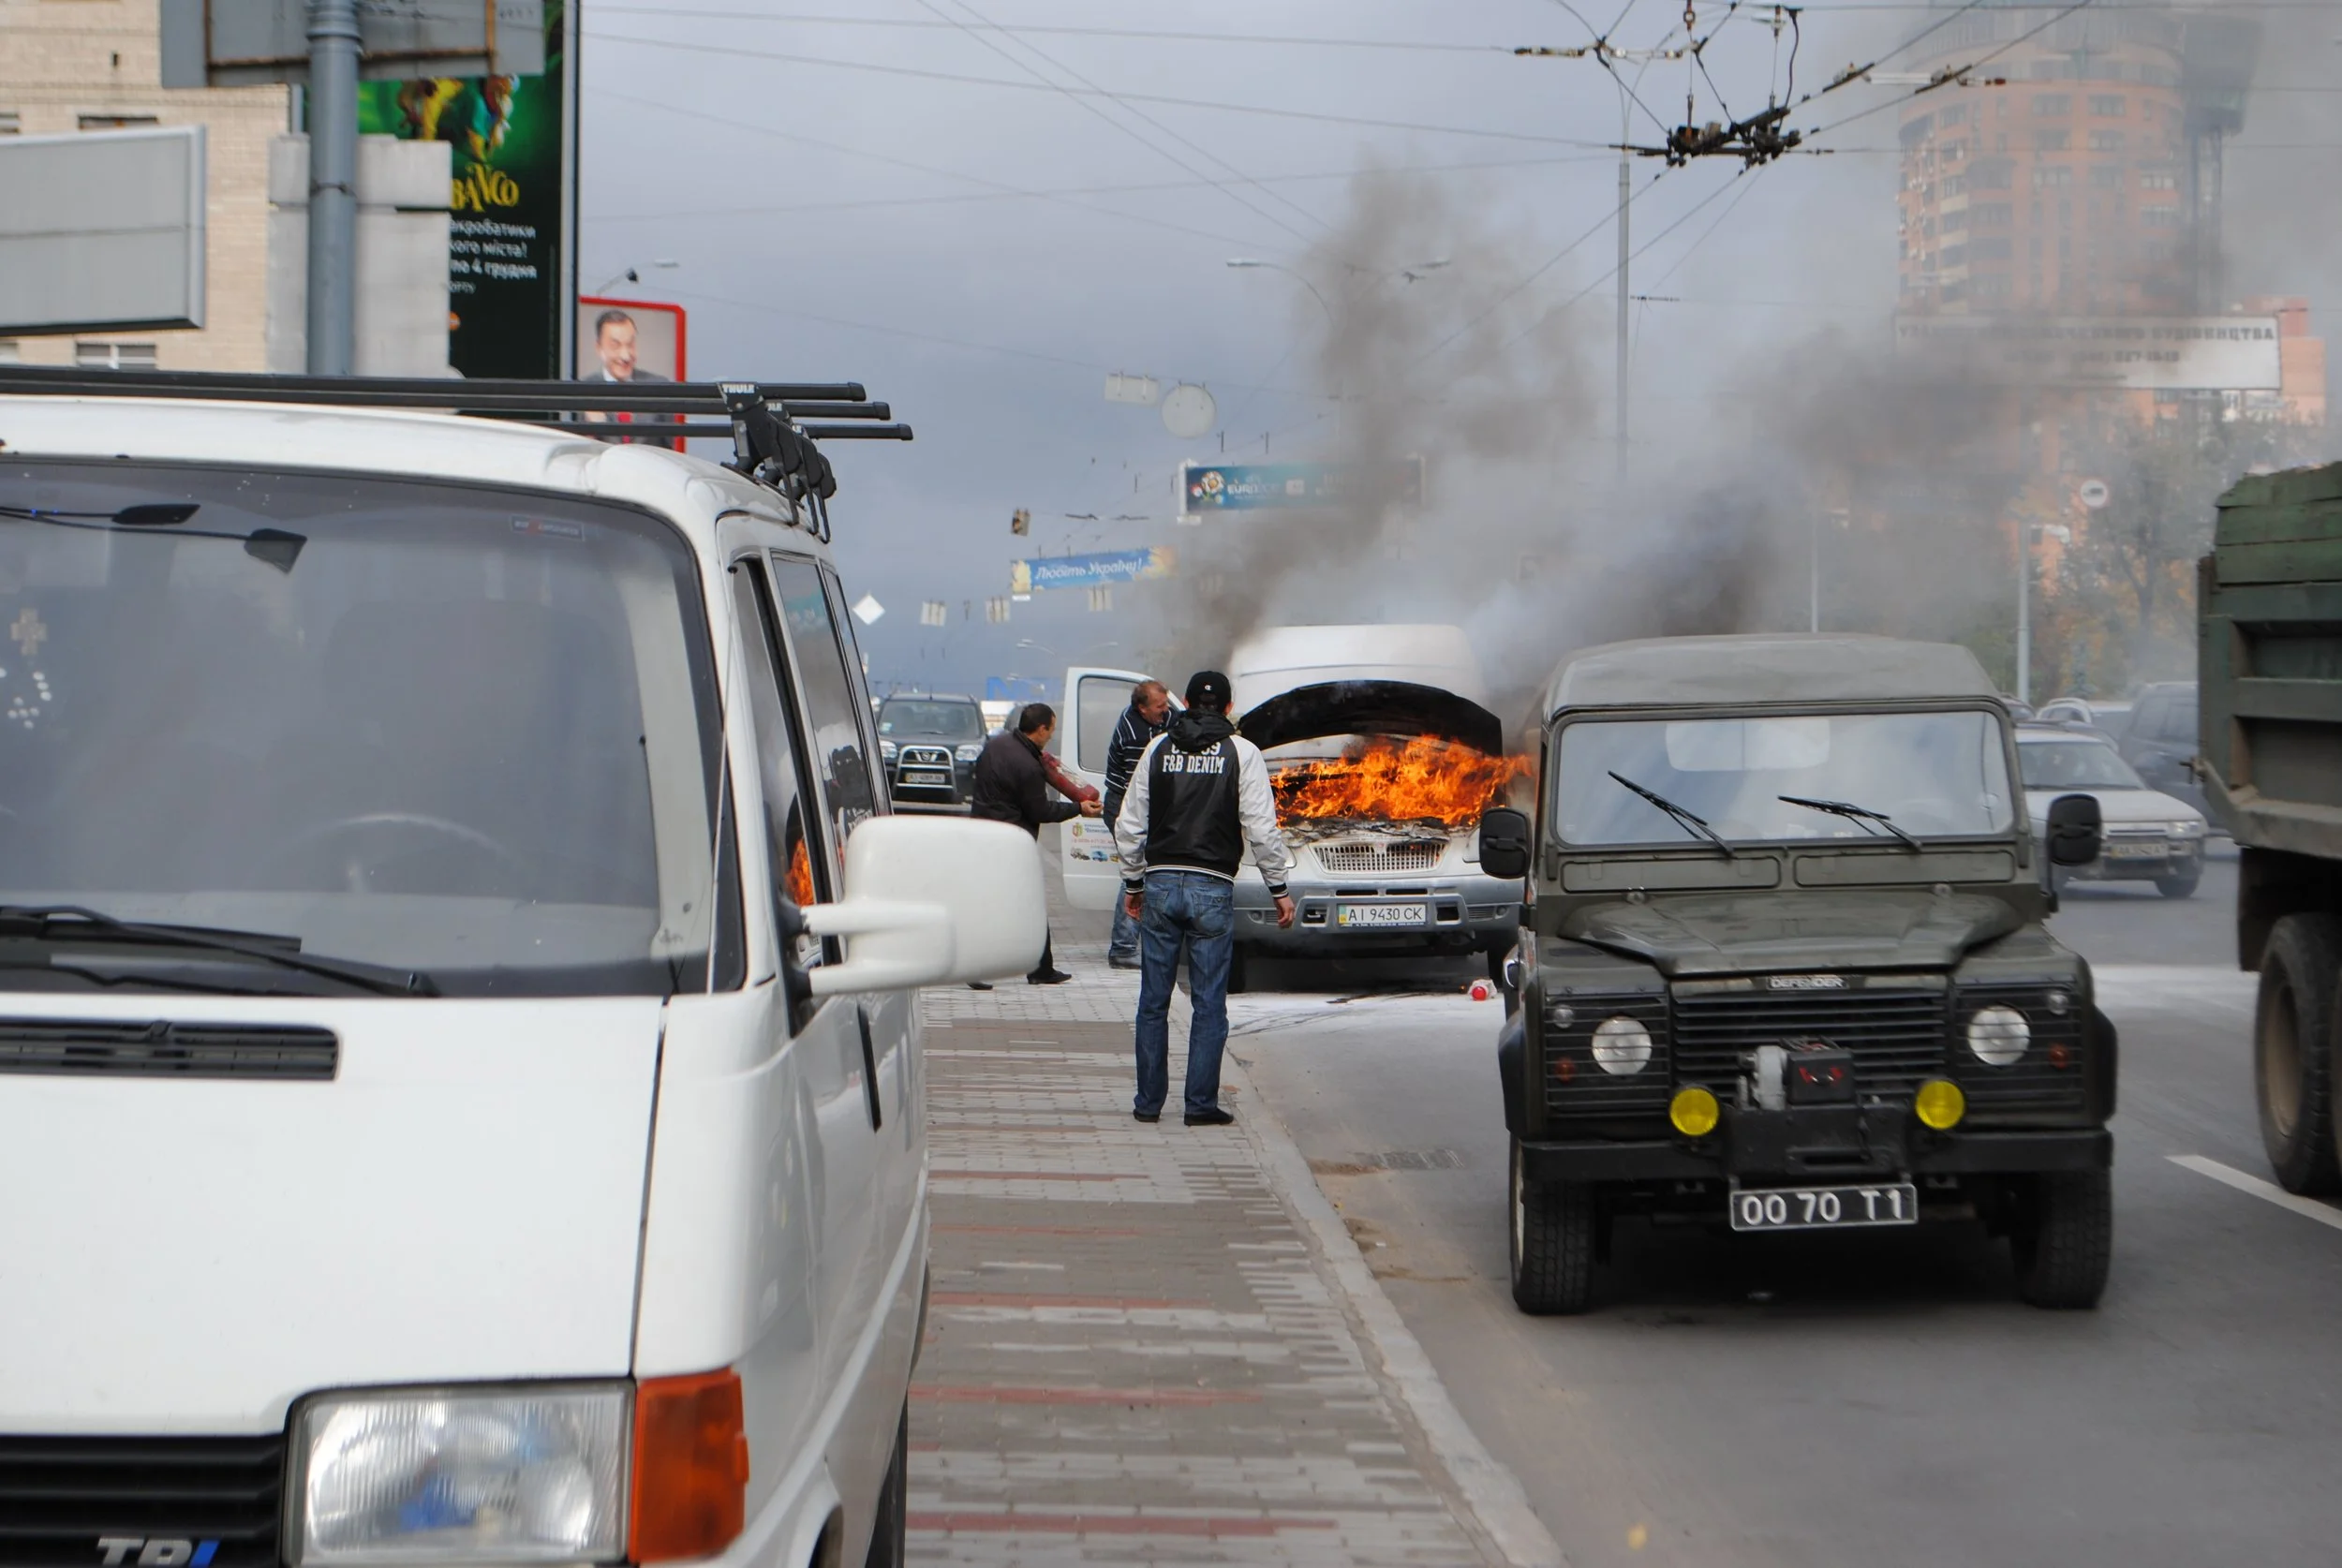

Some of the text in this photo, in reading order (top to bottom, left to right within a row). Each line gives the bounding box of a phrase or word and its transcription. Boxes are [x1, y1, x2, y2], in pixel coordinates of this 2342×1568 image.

[484, 261, 538, 279] грудня
[1088, 557, 1143, 577] Україну!
[1162, 754, 1224, 774] F&B DENIM
[1370, 908, 1401, 922] 9430
[1403, 907, 1423, 921] CK
[1770, 977, 1844, 989] DEFENDER
[96, 1537, 221, 1568] TDI
